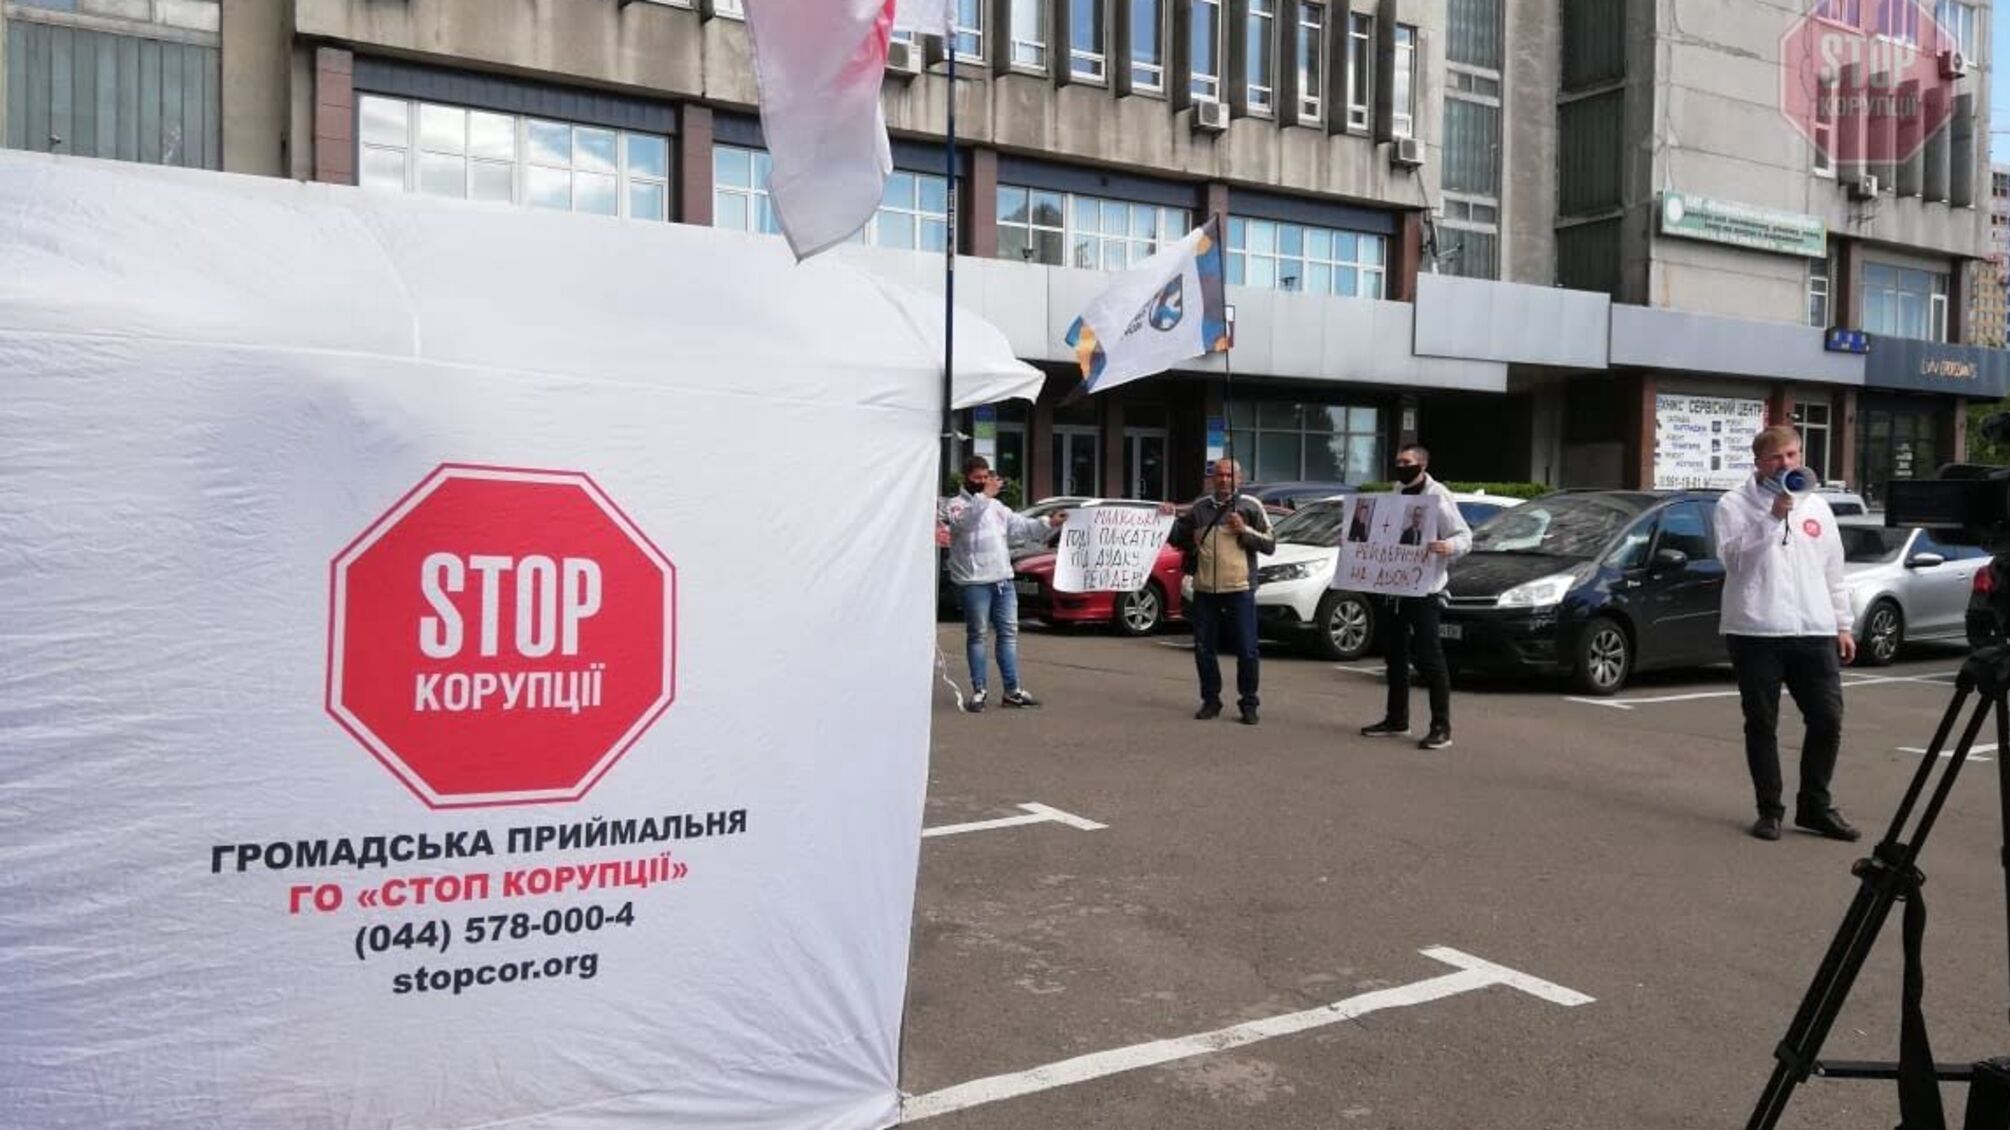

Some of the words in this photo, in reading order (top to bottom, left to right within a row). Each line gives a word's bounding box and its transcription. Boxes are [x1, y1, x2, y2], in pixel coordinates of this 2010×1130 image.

[1689, 398, 1735, 415] СЕРВІСНИЙ
[420, 552, 602, 660] STOP
[414, 663, 605, 713] КОРУПЦІЇ
[211, 829, 494, 874] ГРОМАДСЬКА
[507, 809, 747, 855] ПРИЙМАЛЬНЯ
[289, 884, 343, 914] ГО
[358, 873, 490, 909] «СТОП
[503, 851, 688, 897] КОРУПЦІЇ»
[354, 919, 452, 960] (044)
[465, 901, 635, 944] 578-000-4
[392, 953, 598, 995] stopcor.org
